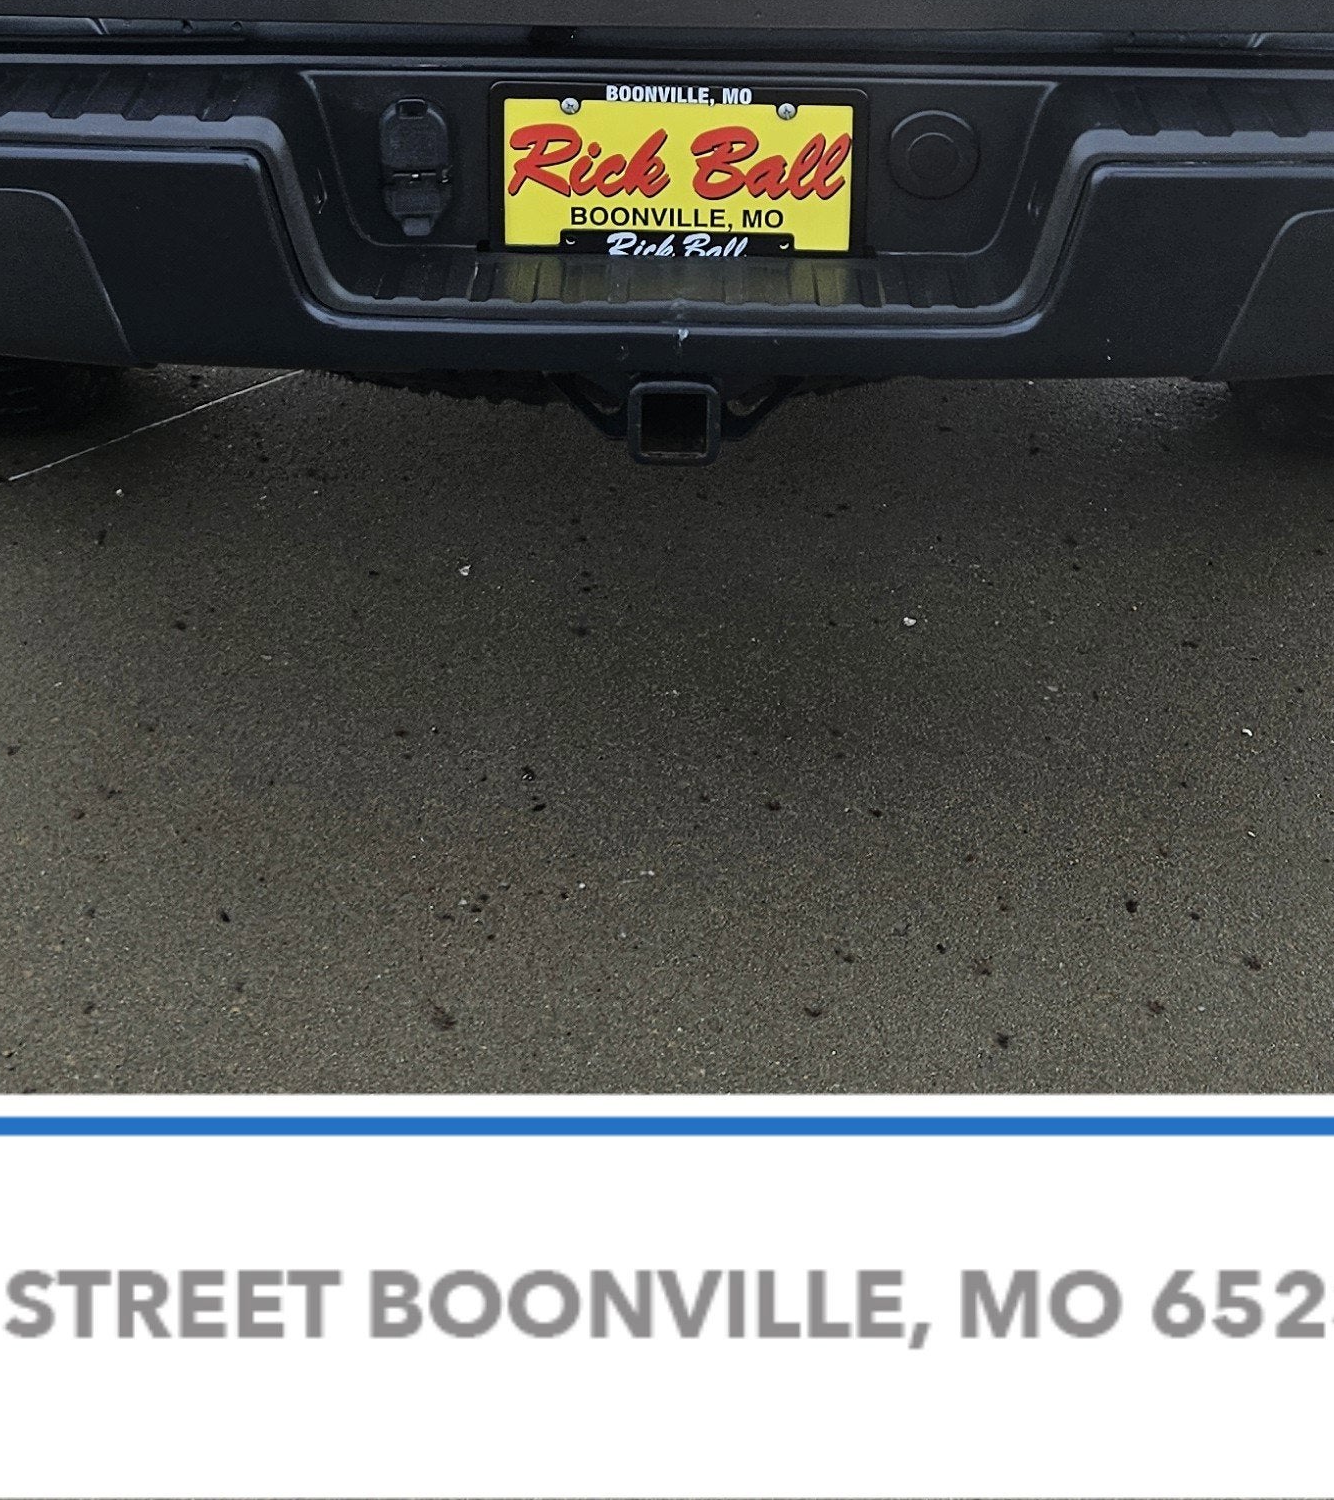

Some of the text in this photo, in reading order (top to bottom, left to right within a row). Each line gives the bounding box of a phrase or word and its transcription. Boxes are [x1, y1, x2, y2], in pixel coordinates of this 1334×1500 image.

[605, 84, 752, 106] BOONVILLE, MO
[507, 123, 853, 201] Rick Ball
[569, 206, 785, 232] BOONVILLE, MO
